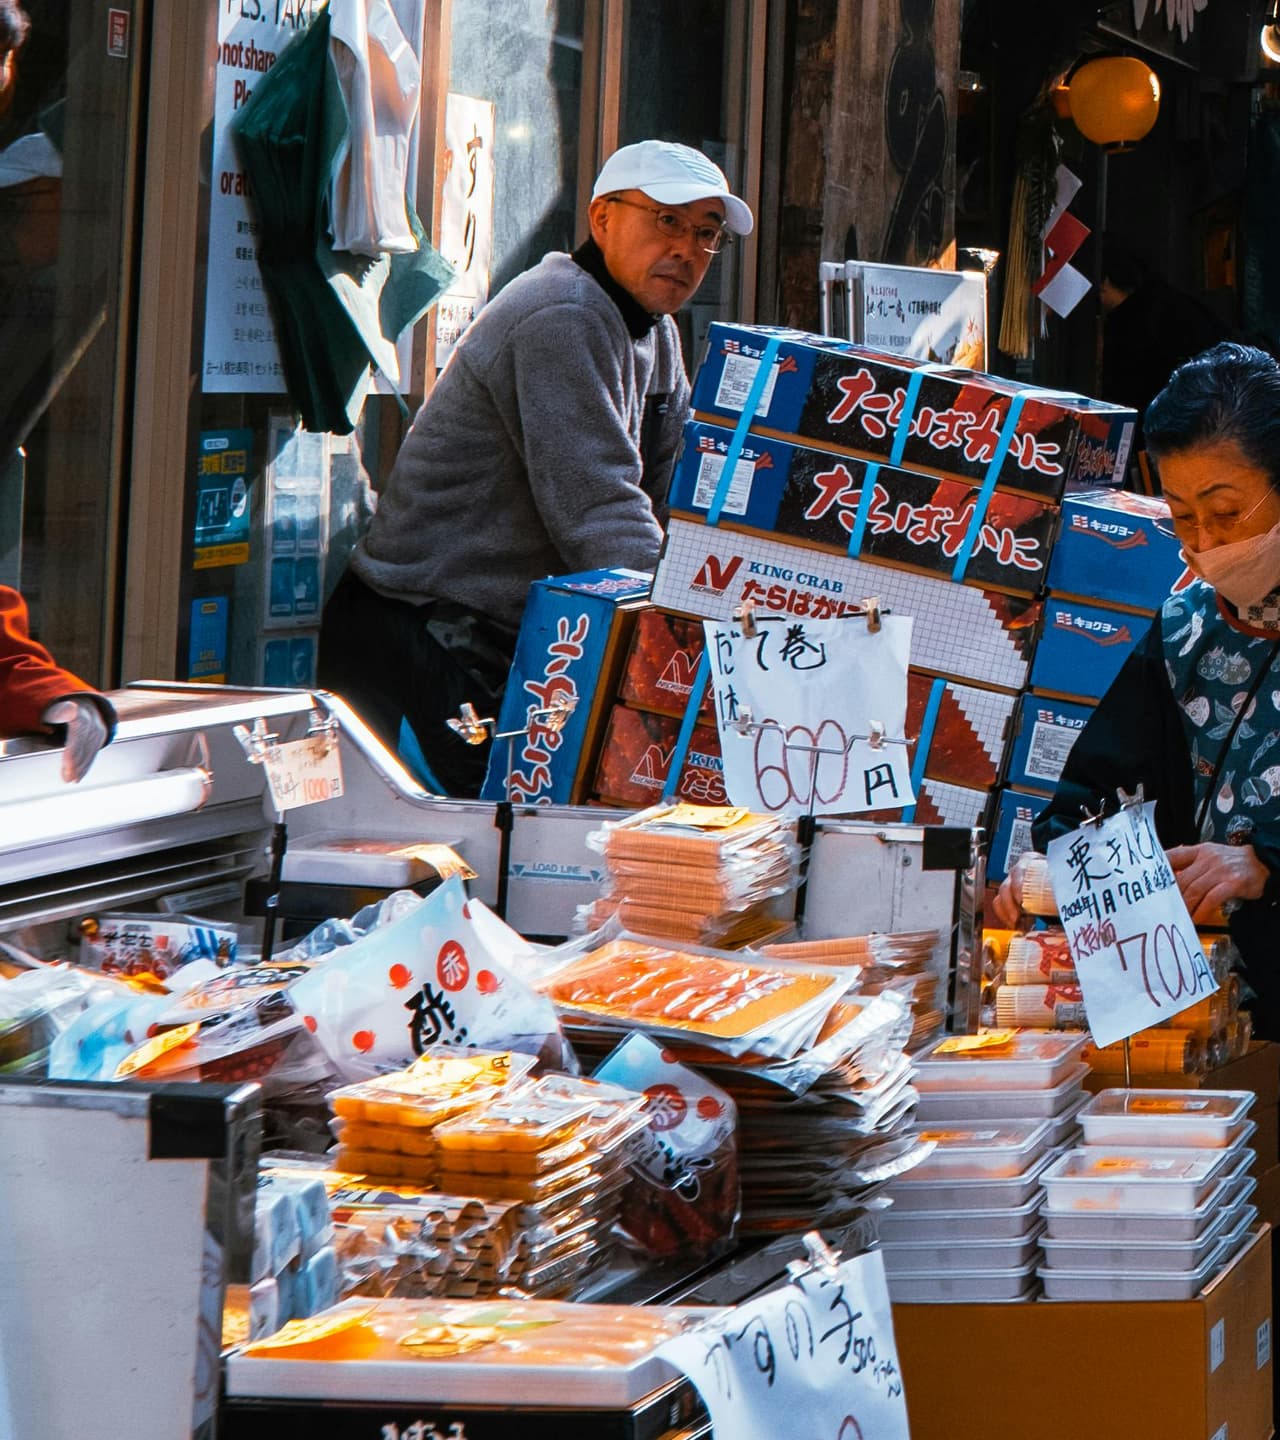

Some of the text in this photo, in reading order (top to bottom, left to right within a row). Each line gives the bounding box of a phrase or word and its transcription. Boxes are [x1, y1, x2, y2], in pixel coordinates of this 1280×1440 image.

[740, 344, 786, 363] キョー
[716, 441, 761, 462] キヨー
[1090, 519, 1136, 537] キョクヨー
[747, 561, 845, 594] KING CRAB
[1074, 616, 1119, 634] キョクヨー
[689, 752, 725, 770] KIN
[532, 863, 582, 875] LOAD LINE
[441, 949, 466, 988] 赤
